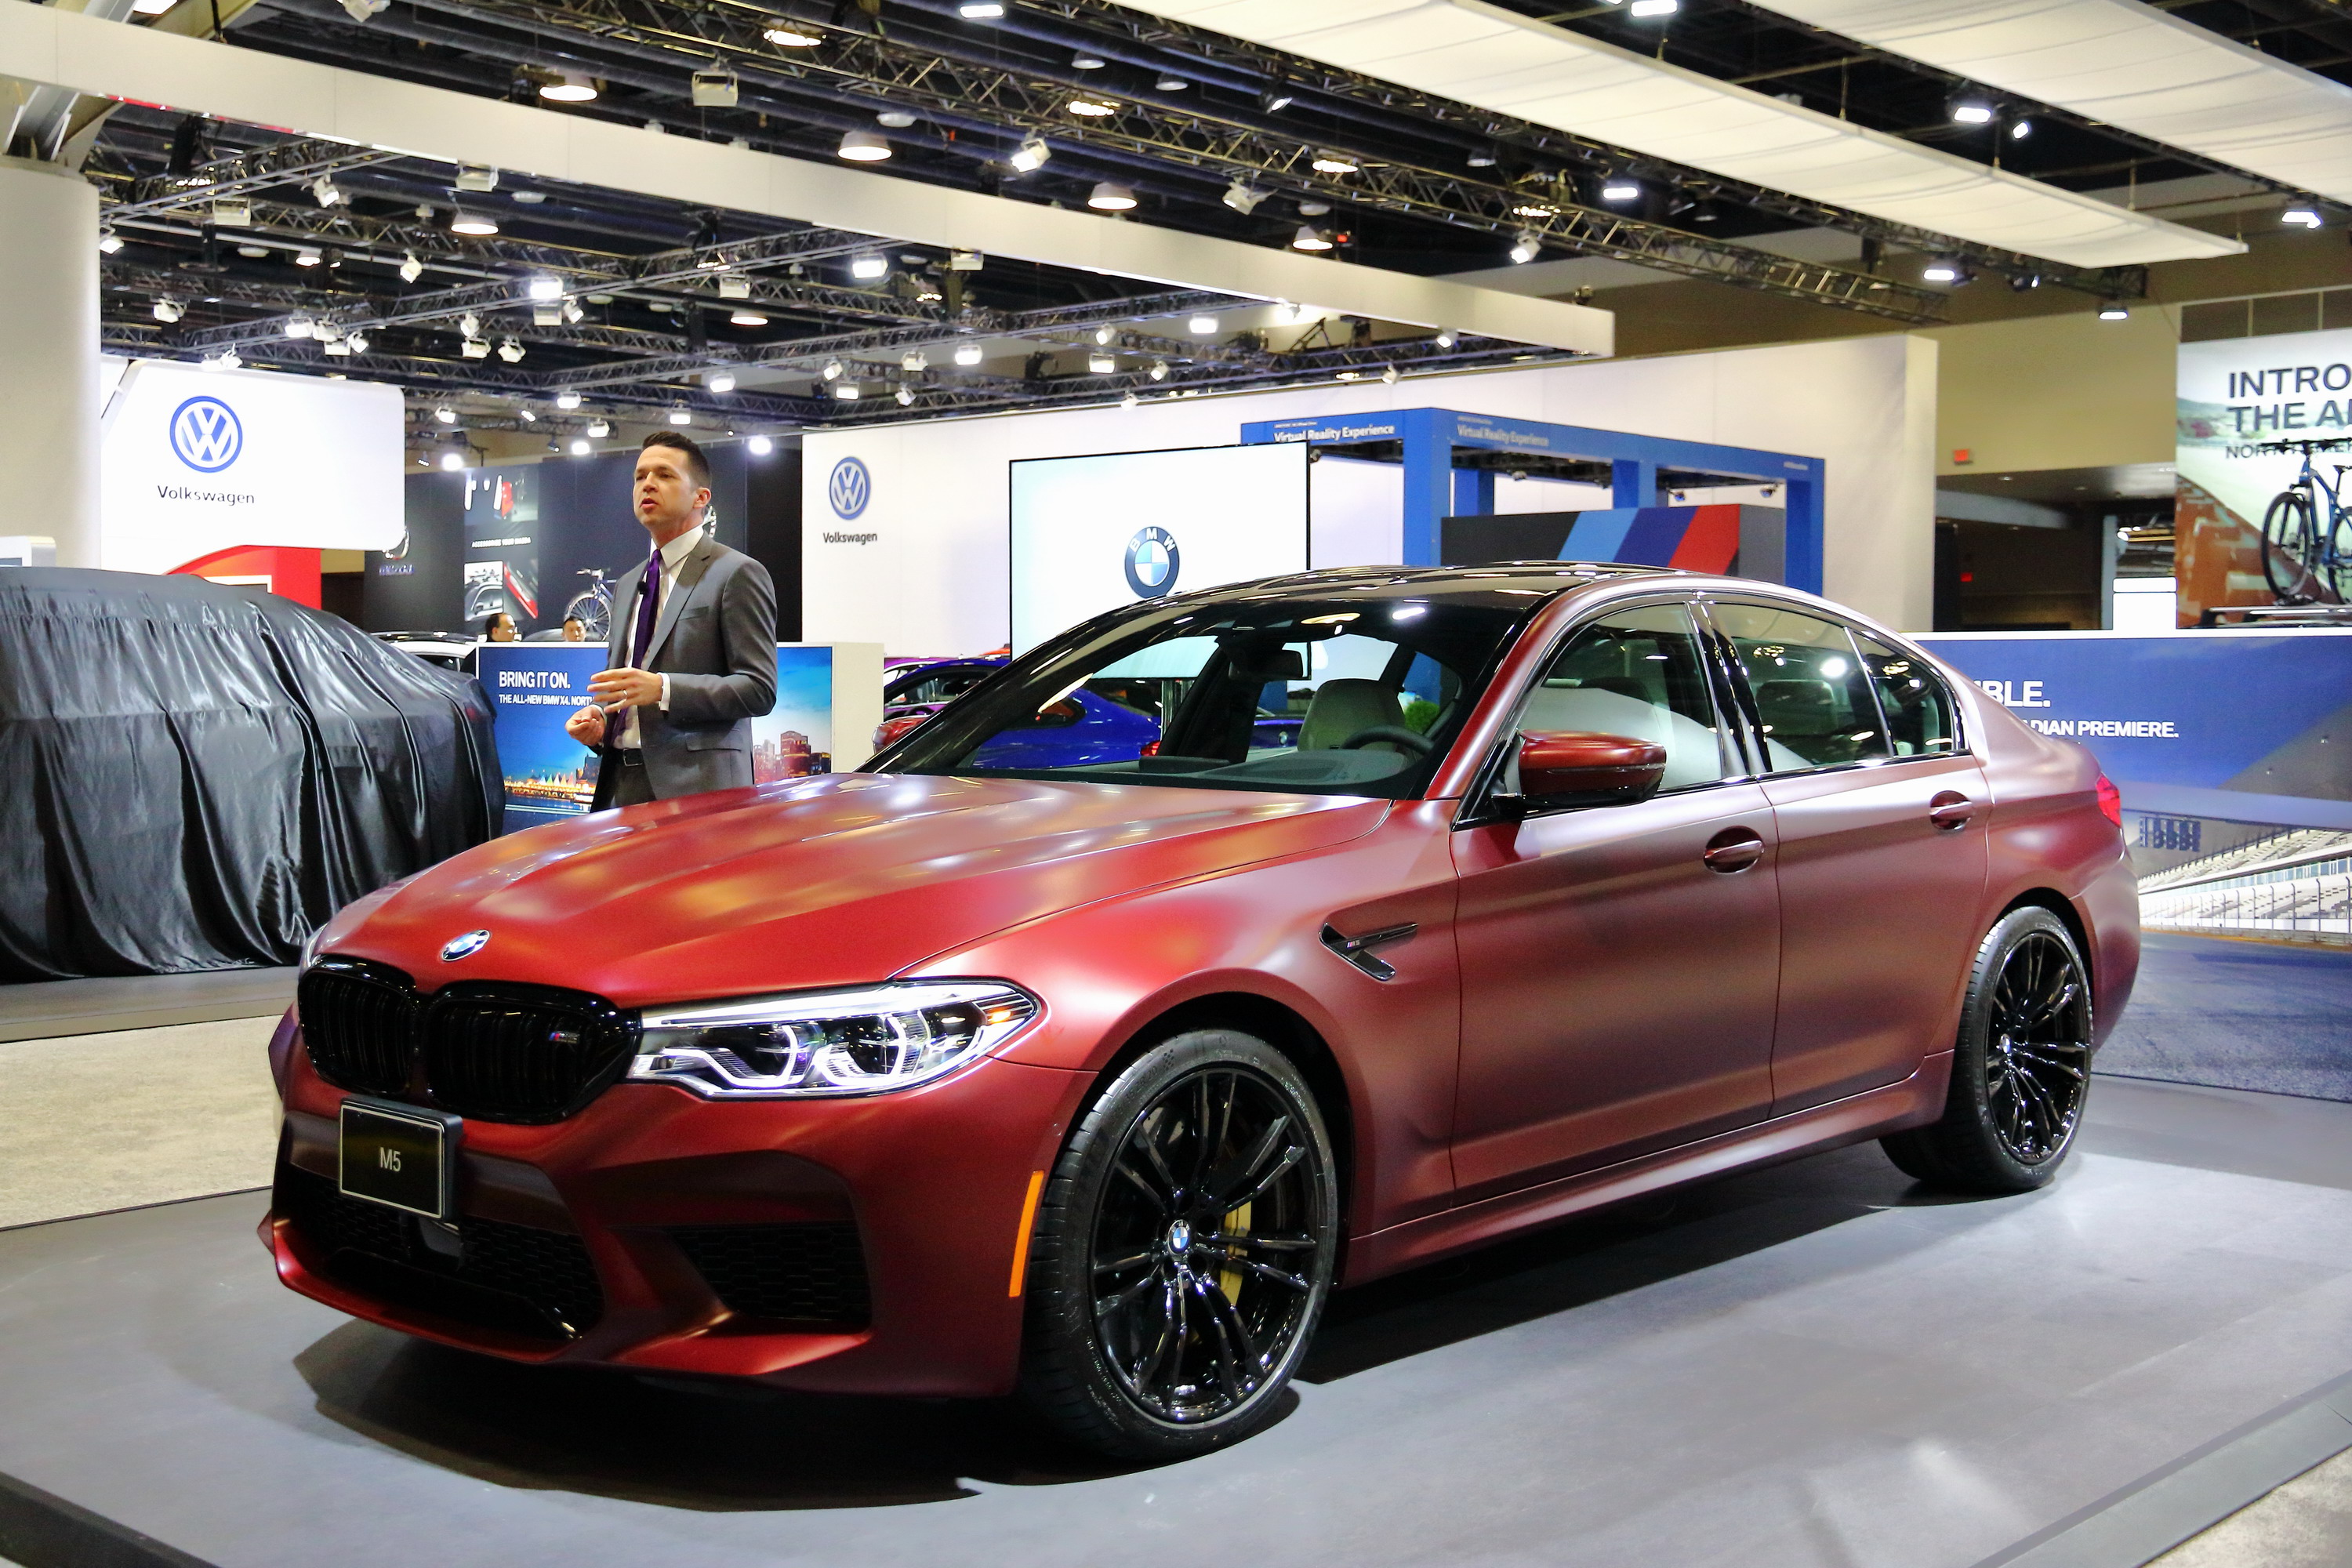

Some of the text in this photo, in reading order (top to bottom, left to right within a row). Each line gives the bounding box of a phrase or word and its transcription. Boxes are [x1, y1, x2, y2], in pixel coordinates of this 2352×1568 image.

[2229, 364, 2352, 398] INTRO
[2226, 402, 2307, 431] THE
[1274, 423, 1395, 442] Virtual Reality Experience
[158, 485, 255, 506] Volkswagen
[822, 532, 877, 546] Volkswagen
[1129, 527, 1177, 553] BMW
[499, 671, 571, 689] BRING IT ON.
[499, 694, 513, 704] THE
[513, 695, 543, 705] ALL-NEW
[543, 695, 560, 706] BMW
[560, 695, 571, 706] X4.
[2022, 719, 2180, 739] DIAN PREMIERE.
[380, 1147, 401, 1172] M5
